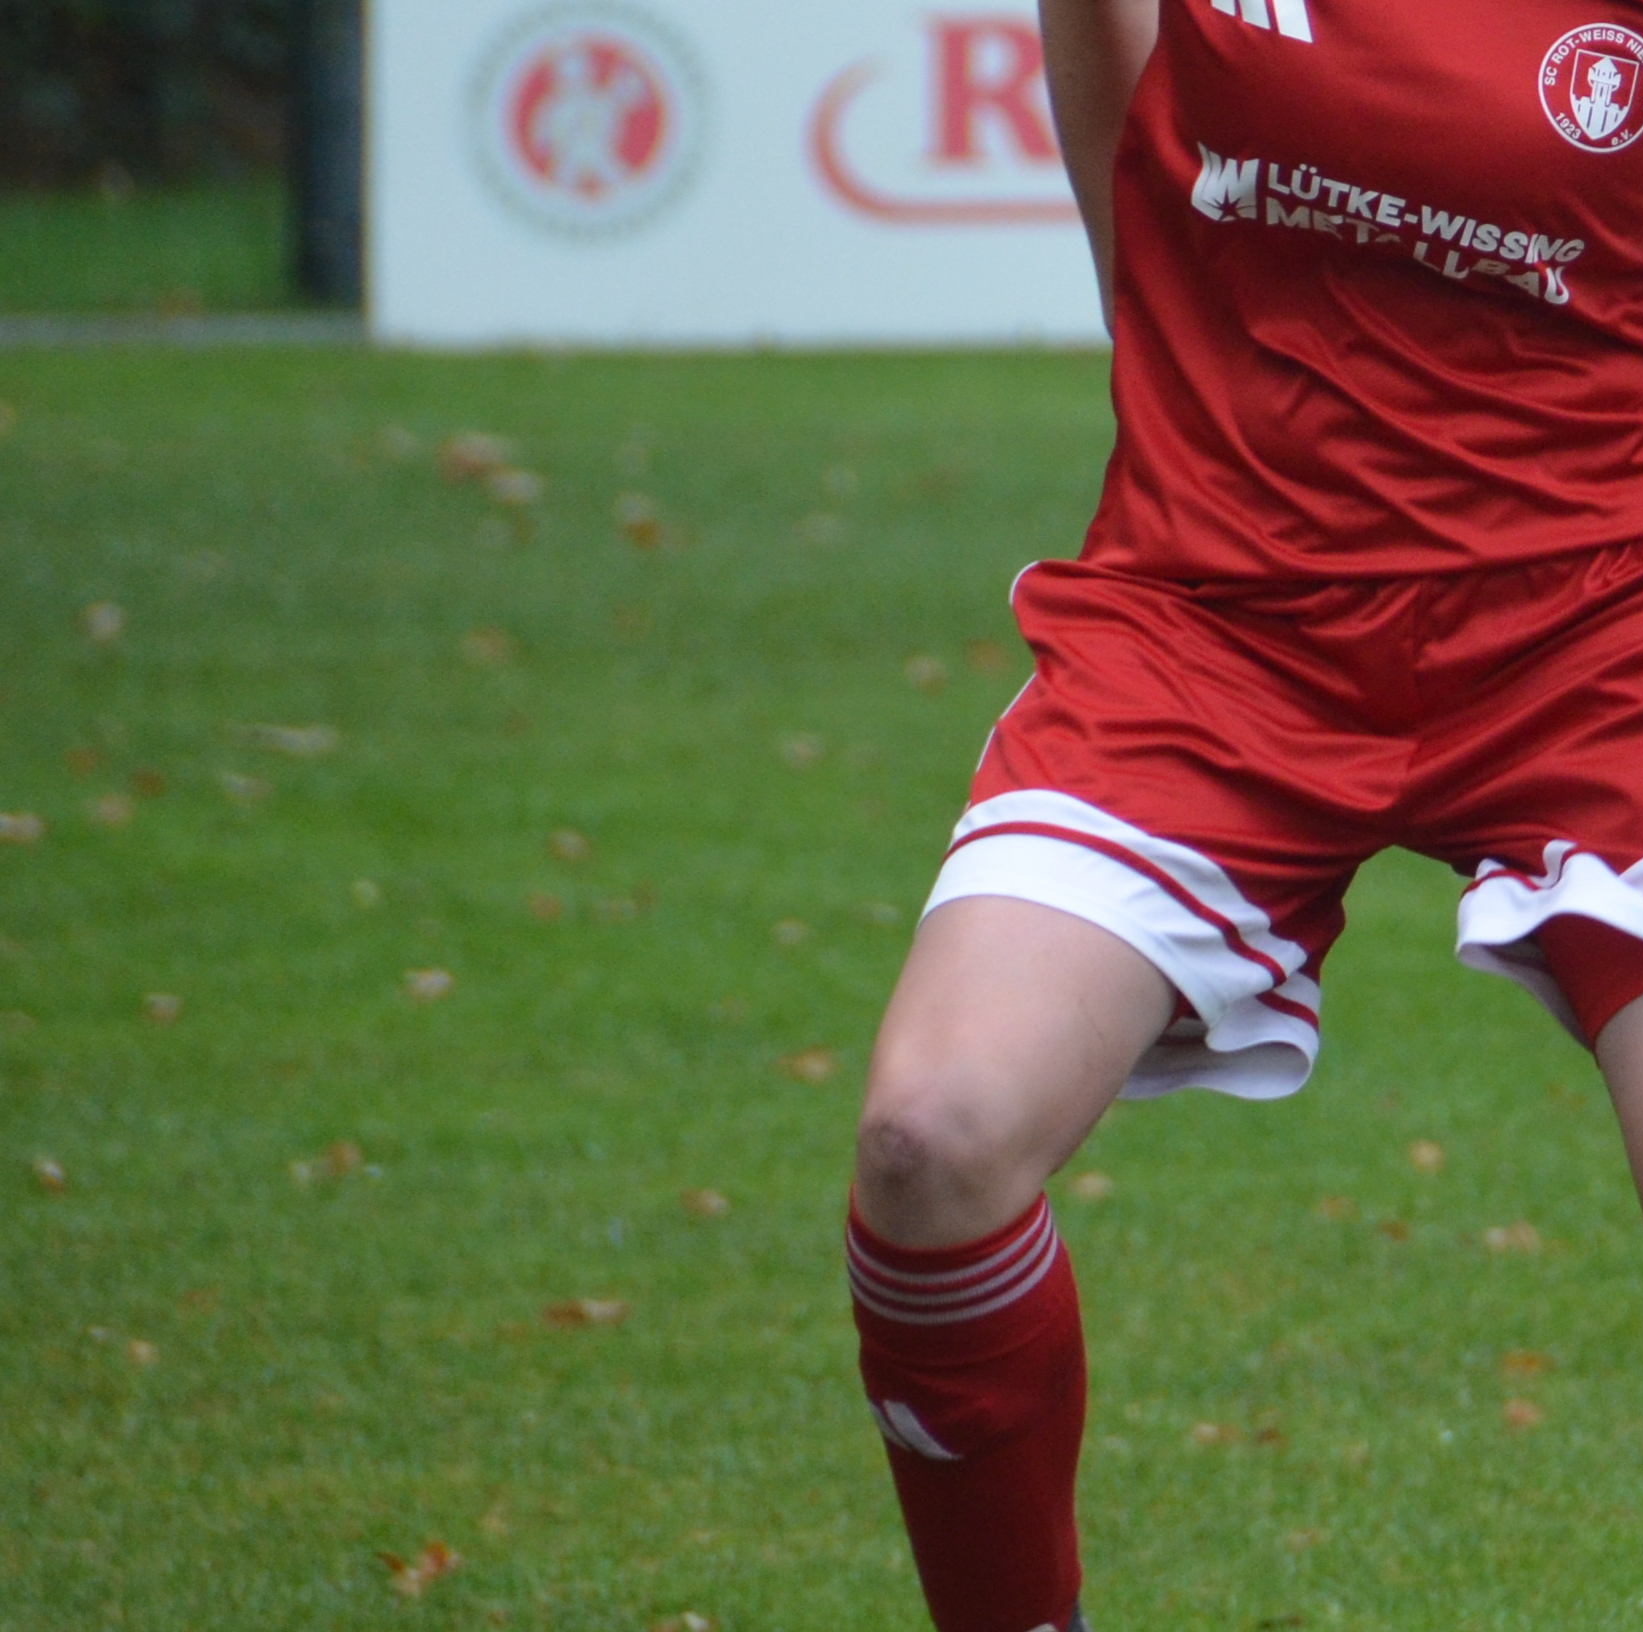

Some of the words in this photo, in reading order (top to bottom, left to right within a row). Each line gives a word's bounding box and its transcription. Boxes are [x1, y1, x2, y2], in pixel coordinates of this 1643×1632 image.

[1544, 66, 1558, 86] SC
[1551, 29, 1625, 64] ROT-WEISS
[1555, 112, 1582, 140] 1923
[1611, 129, 1634, 146] e.V.
[1267, 163, 1585, 264] LÜTKE-WISSING
